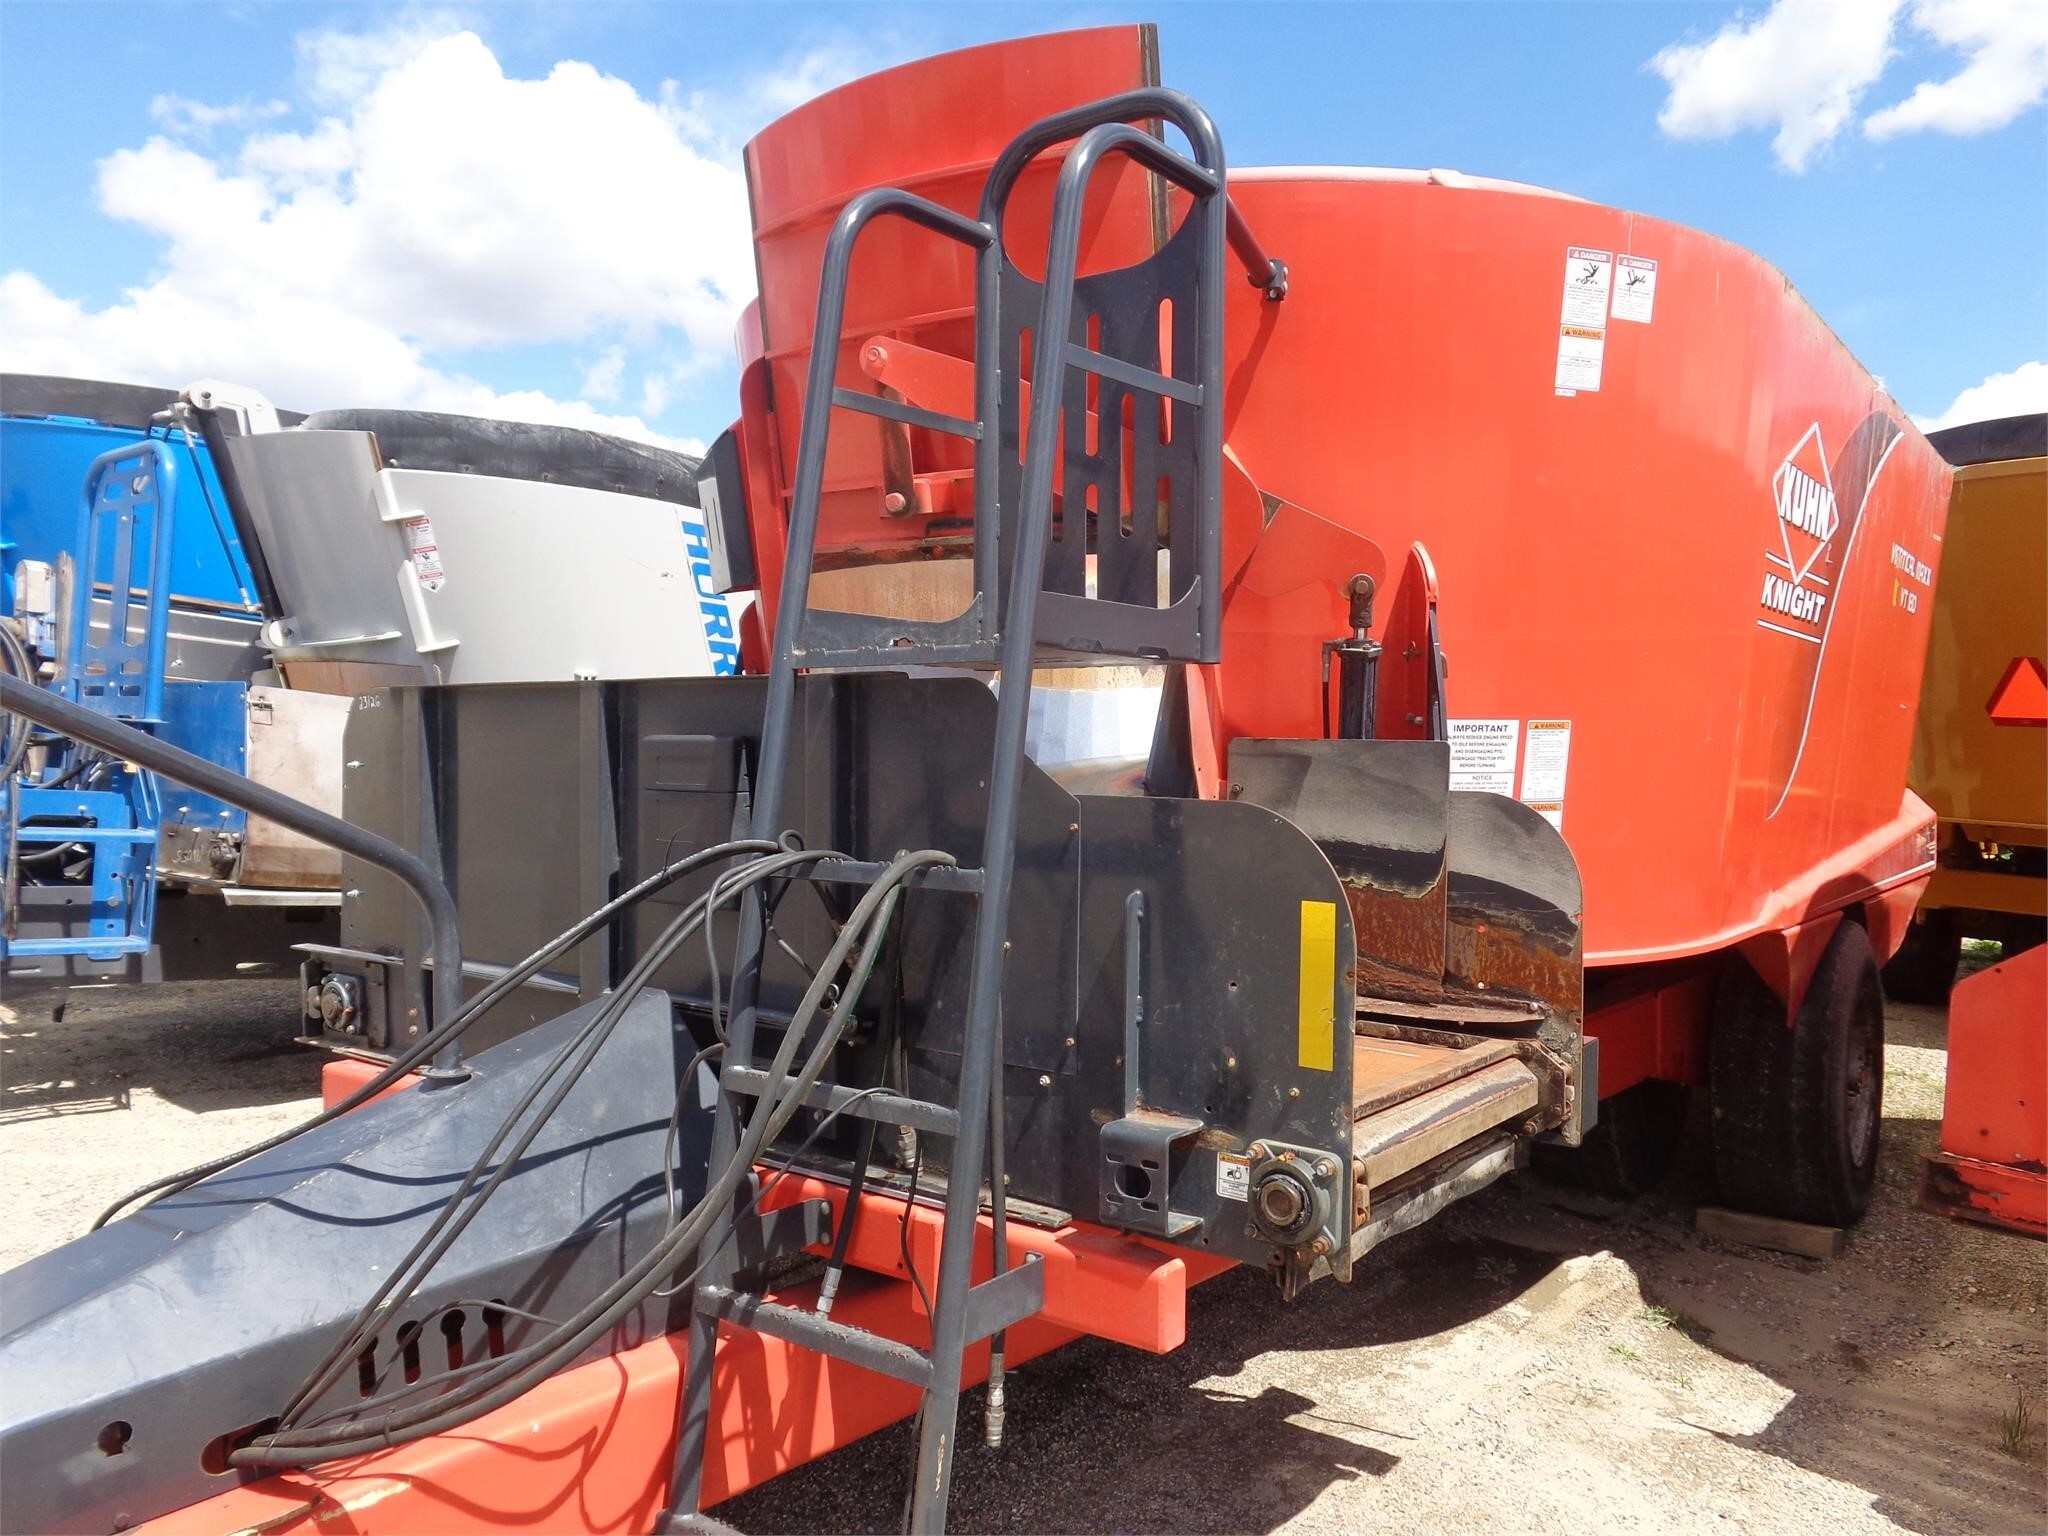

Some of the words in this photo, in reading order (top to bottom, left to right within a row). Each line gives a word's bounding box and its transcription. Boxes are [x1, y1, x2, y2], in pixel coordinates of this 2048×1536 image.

[1579, 251, 1607, 261] DANGER
[1629, 260, 1653, 269] DANGER
[1571, 329, 1602, 339] WARNING
[1779, 461, 1835, 541] KUHN
[1891, 541, 1915, 578] VERTICAL
[1760, 573, 1827, 627] KNIGHT
[1453, 724, 1509, 733] IMPORTANT
